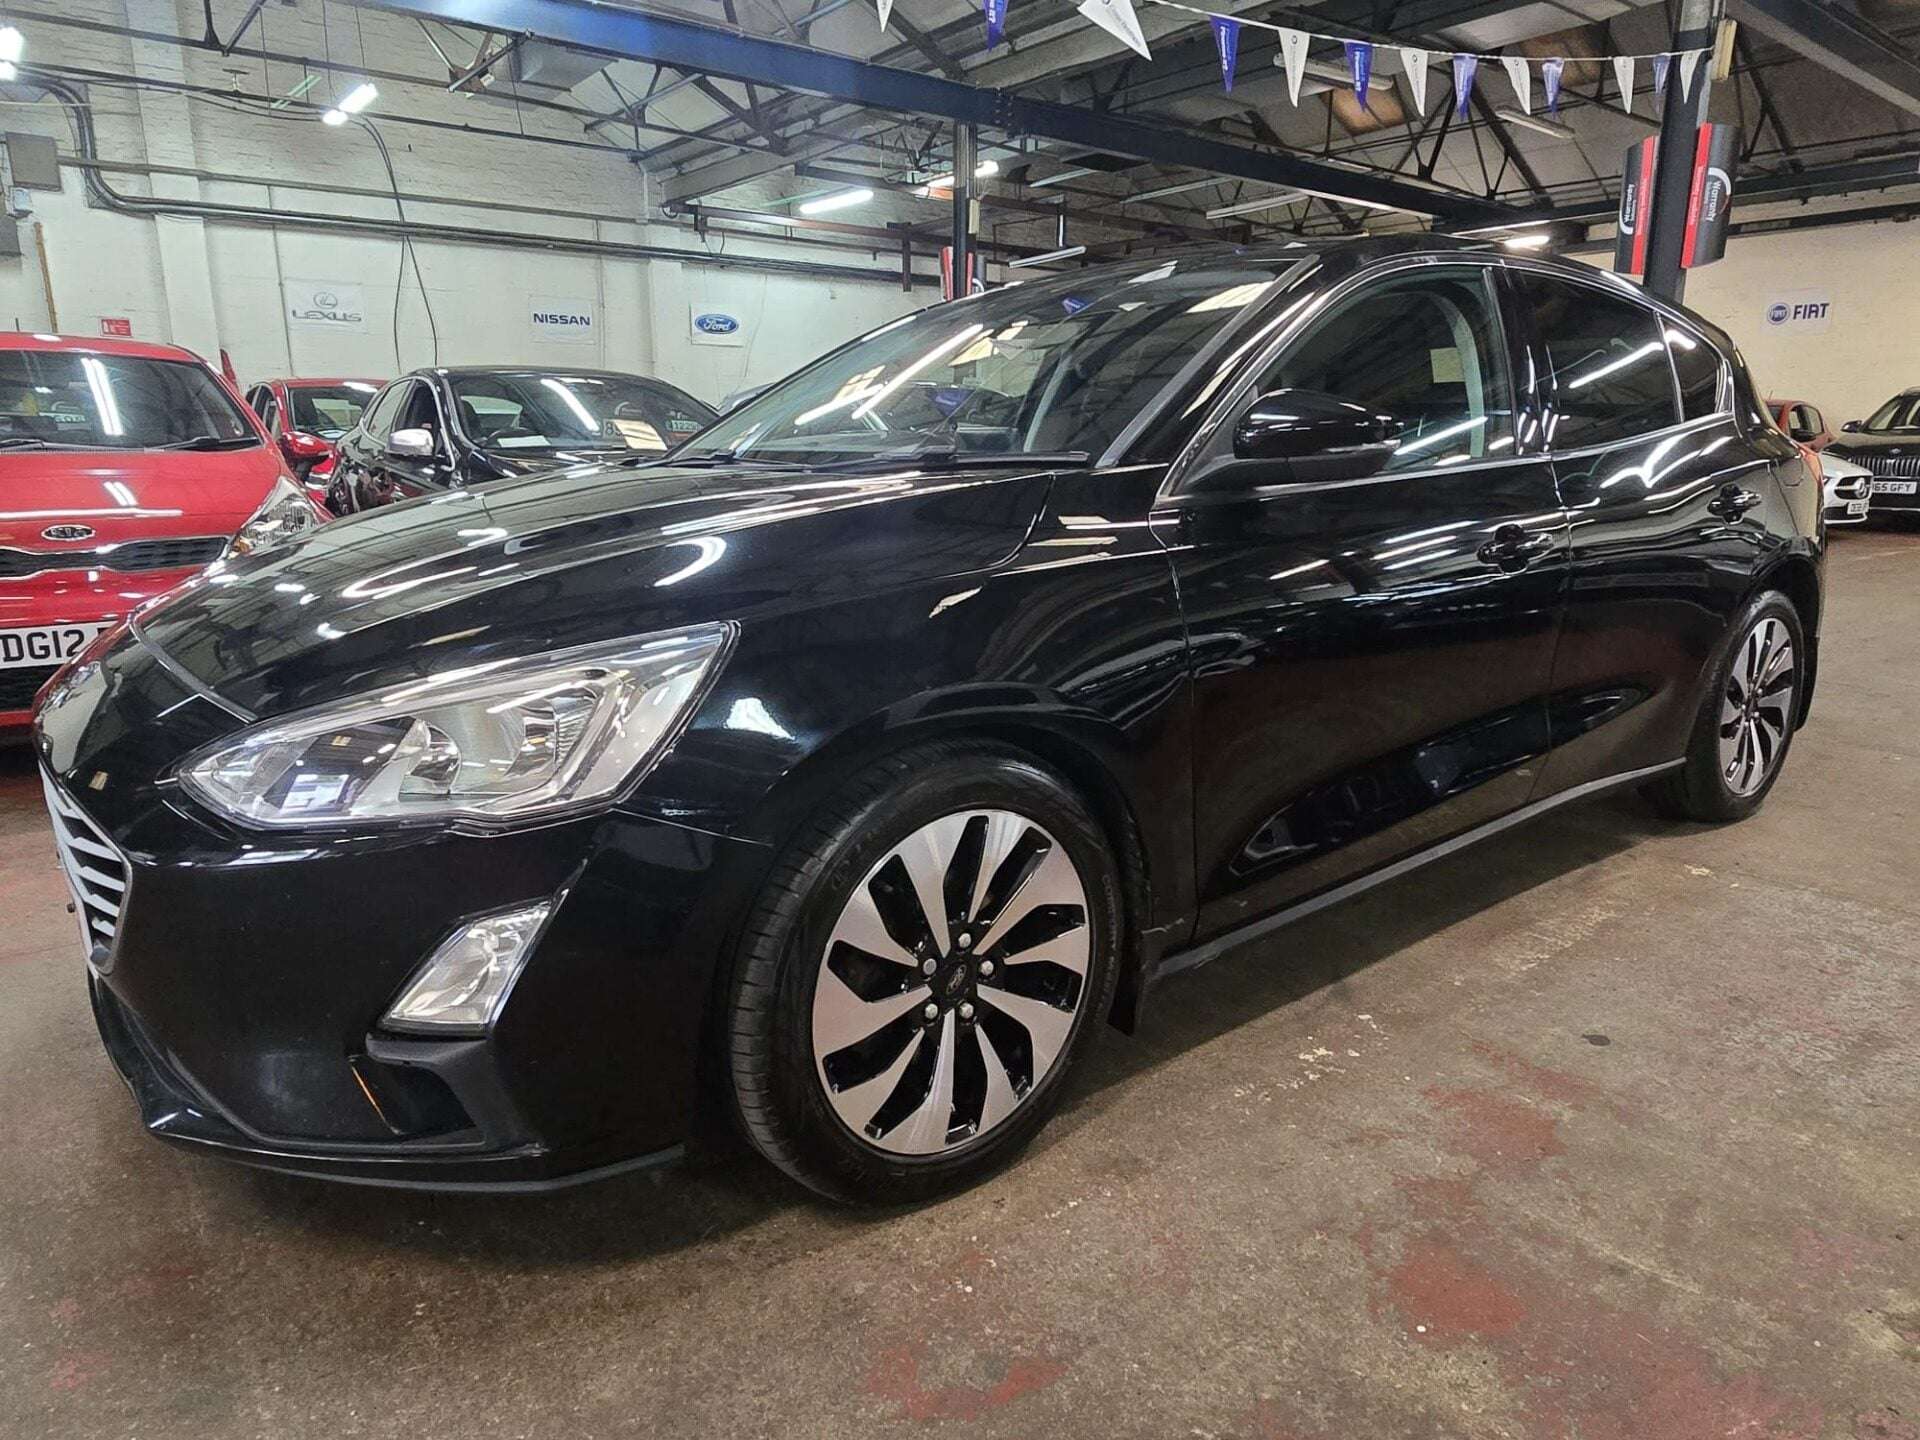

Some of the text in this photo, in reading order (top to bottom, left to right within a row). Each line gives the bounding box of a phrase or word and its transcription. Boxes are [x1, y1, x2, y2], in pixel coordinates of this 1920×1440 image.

[1624, 184, 1634, 222] Warranty
[1705, 181, 1721, 221] Warranty
[292, 309, 362, 323] LEXUS
[1792, 303, 1830, 320] FIAT
[533, 313, 590, 326] NISSAN
[703, 317, 732, 330] Ford
[1890, 483, 1911, 492] GFY
[50, 526, 88, 538] KIA
[0, 629, 85, 662] DG12
